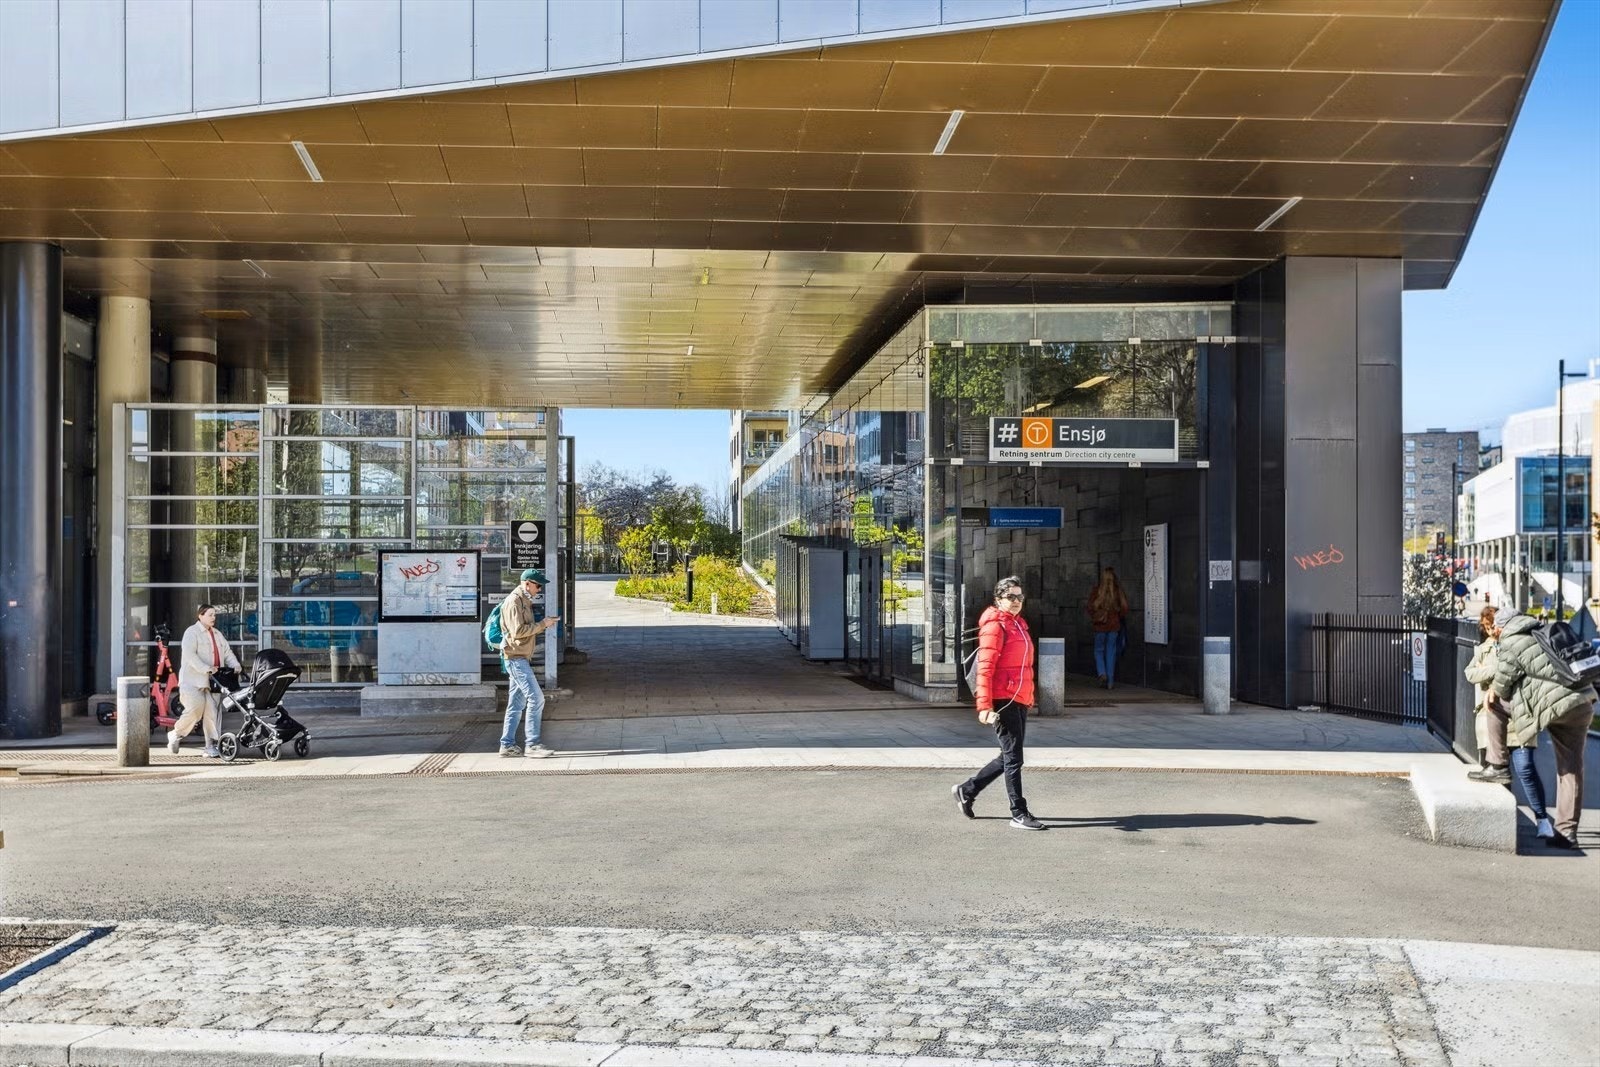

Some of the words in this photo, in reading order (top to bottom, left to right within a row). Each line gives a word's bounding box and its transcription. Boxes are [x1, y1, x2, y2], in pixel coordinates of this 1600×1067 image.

[1059, 425, 1106, 446] Ensjø
[999, 450, 1028, 459] Retning
[1030, 450, 1063, 459] sentrum
[1064, 450, 1097, 459] Direction
[1098, 450, 1112, 460] city
